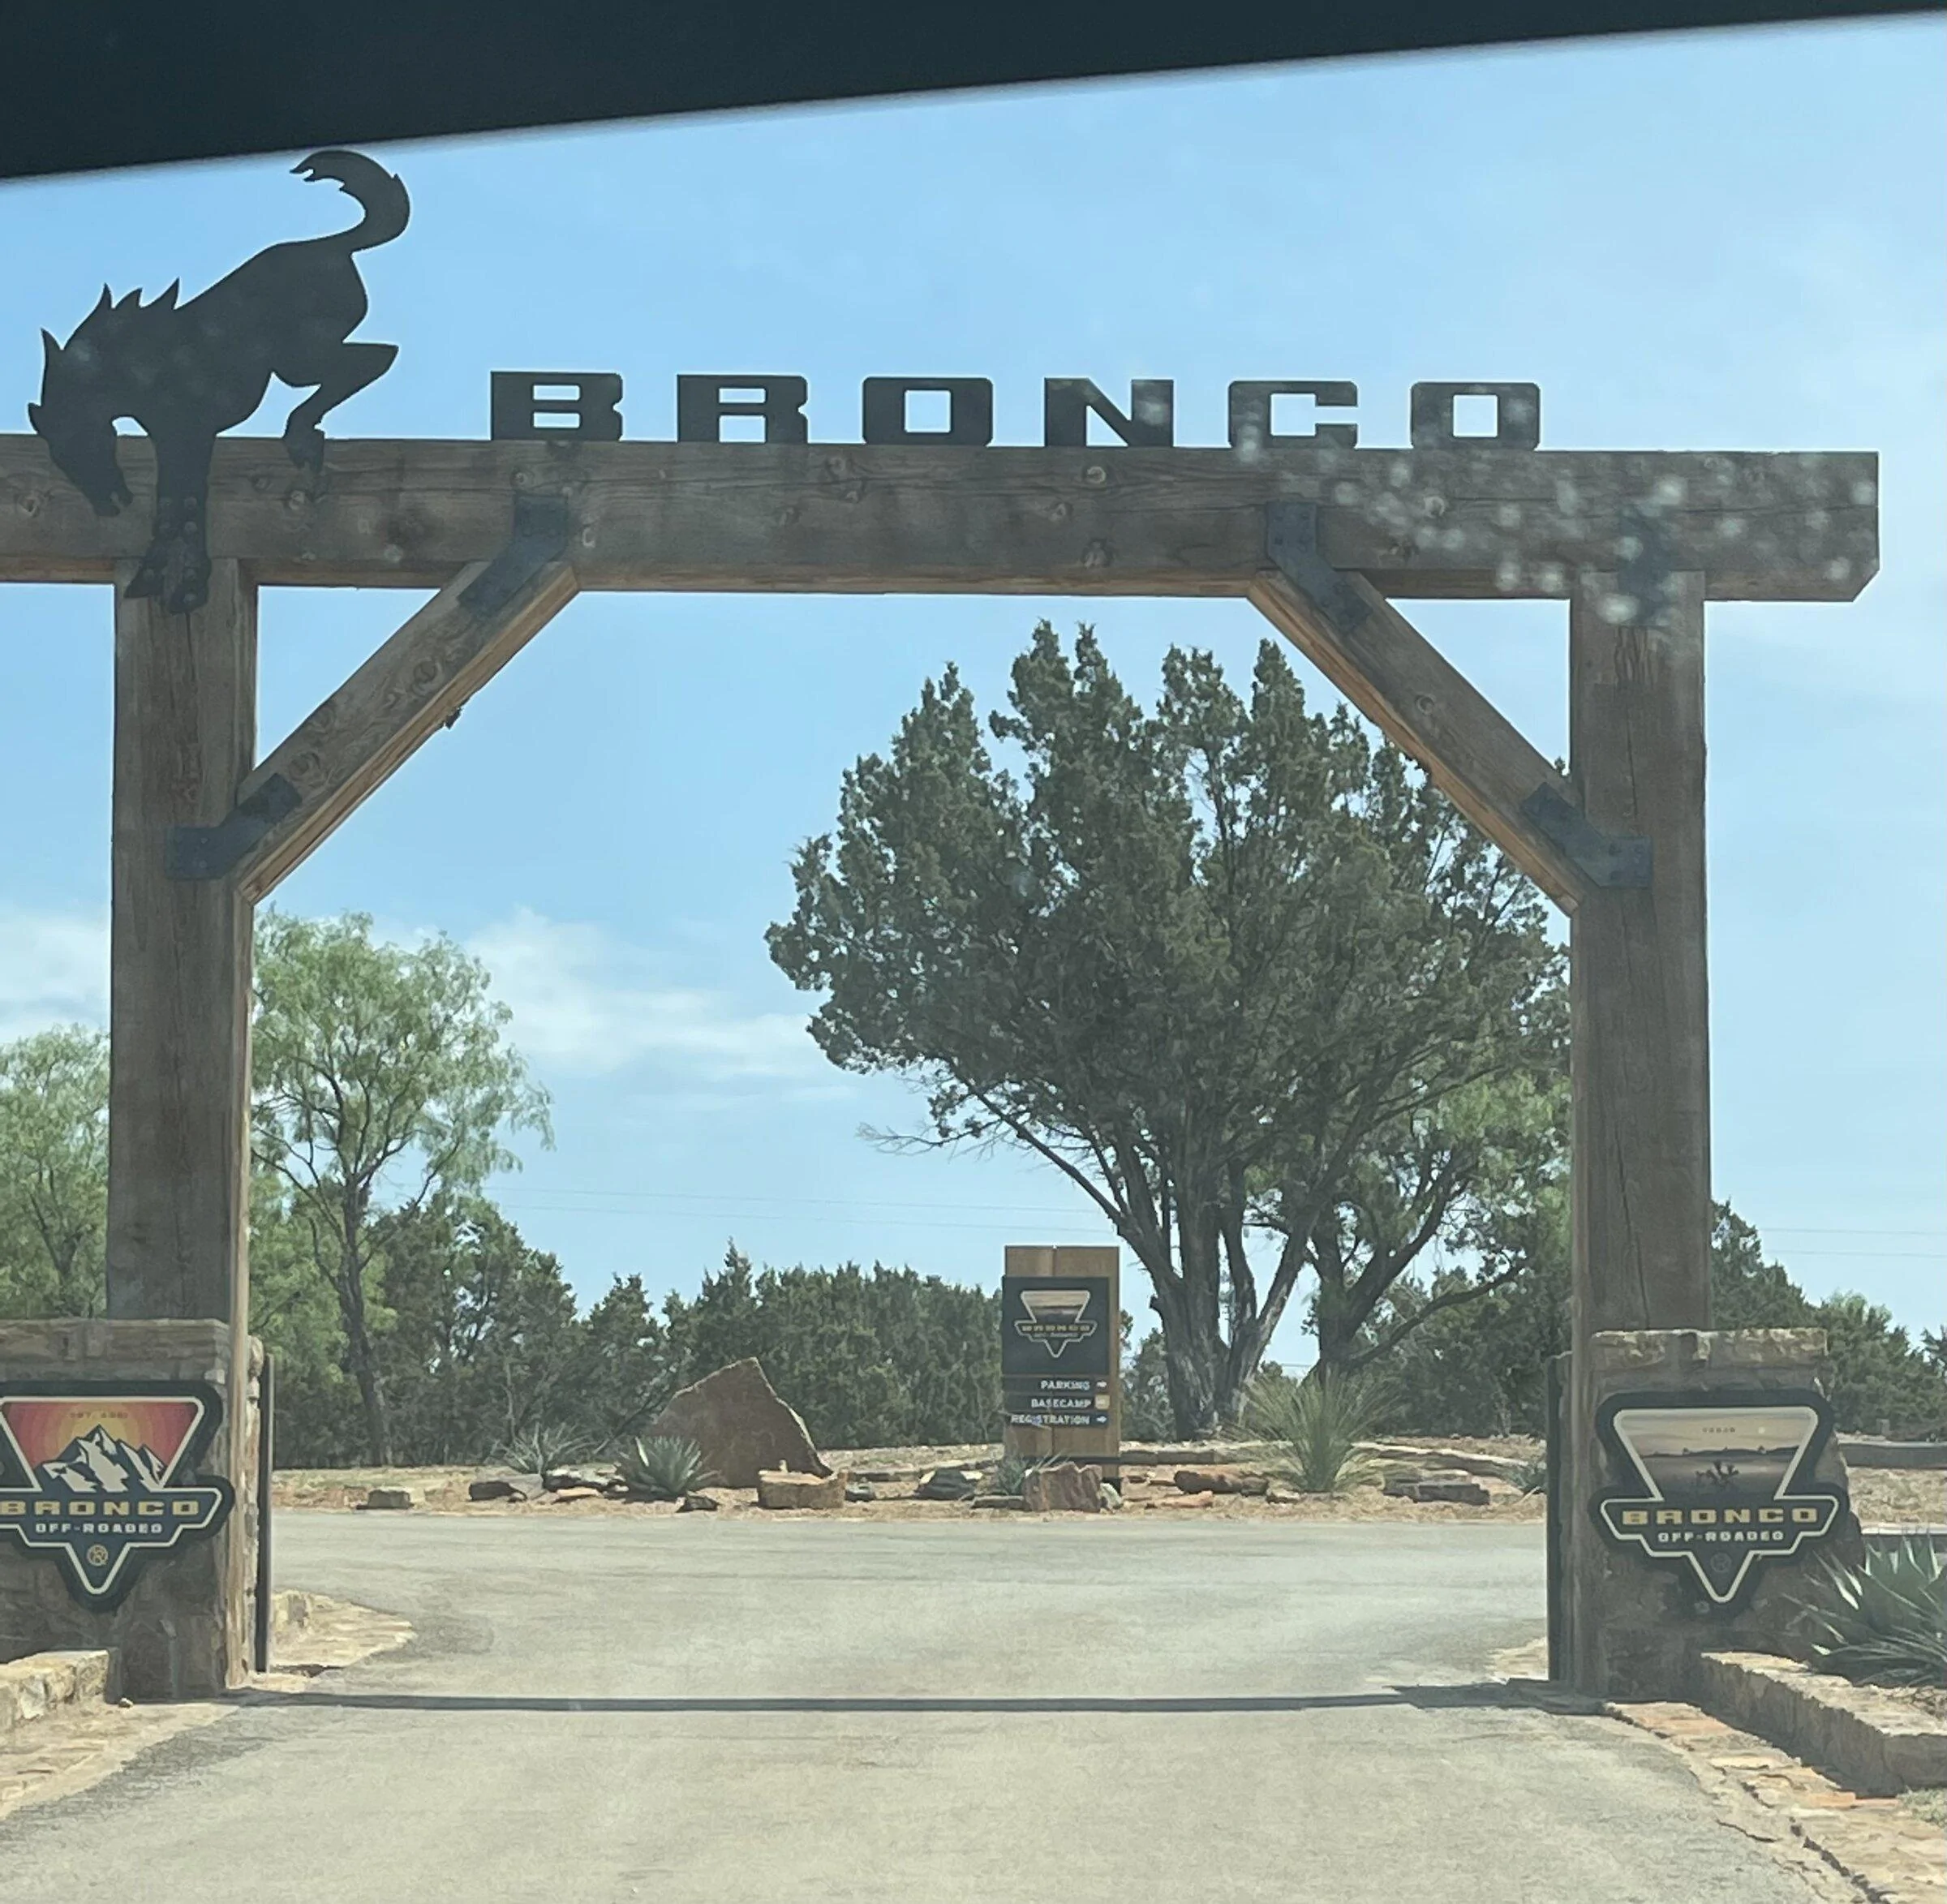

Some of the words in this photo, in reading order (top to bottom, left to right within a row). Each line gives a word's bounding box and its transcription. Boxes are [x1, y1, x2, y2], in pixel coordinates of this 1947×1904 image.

[490, 371, 1541, 452] BRONCO
[1040, 1381, 1090, 1390] PARKING
[1031, 1399, 1091, 1408] BASECAMP
[0, 1501, 199, 1515] BRONCO
[1622, 1508, 1817, 1525] BRONCO
[35, 1523, 162, 1533] OFF-ROADEO
